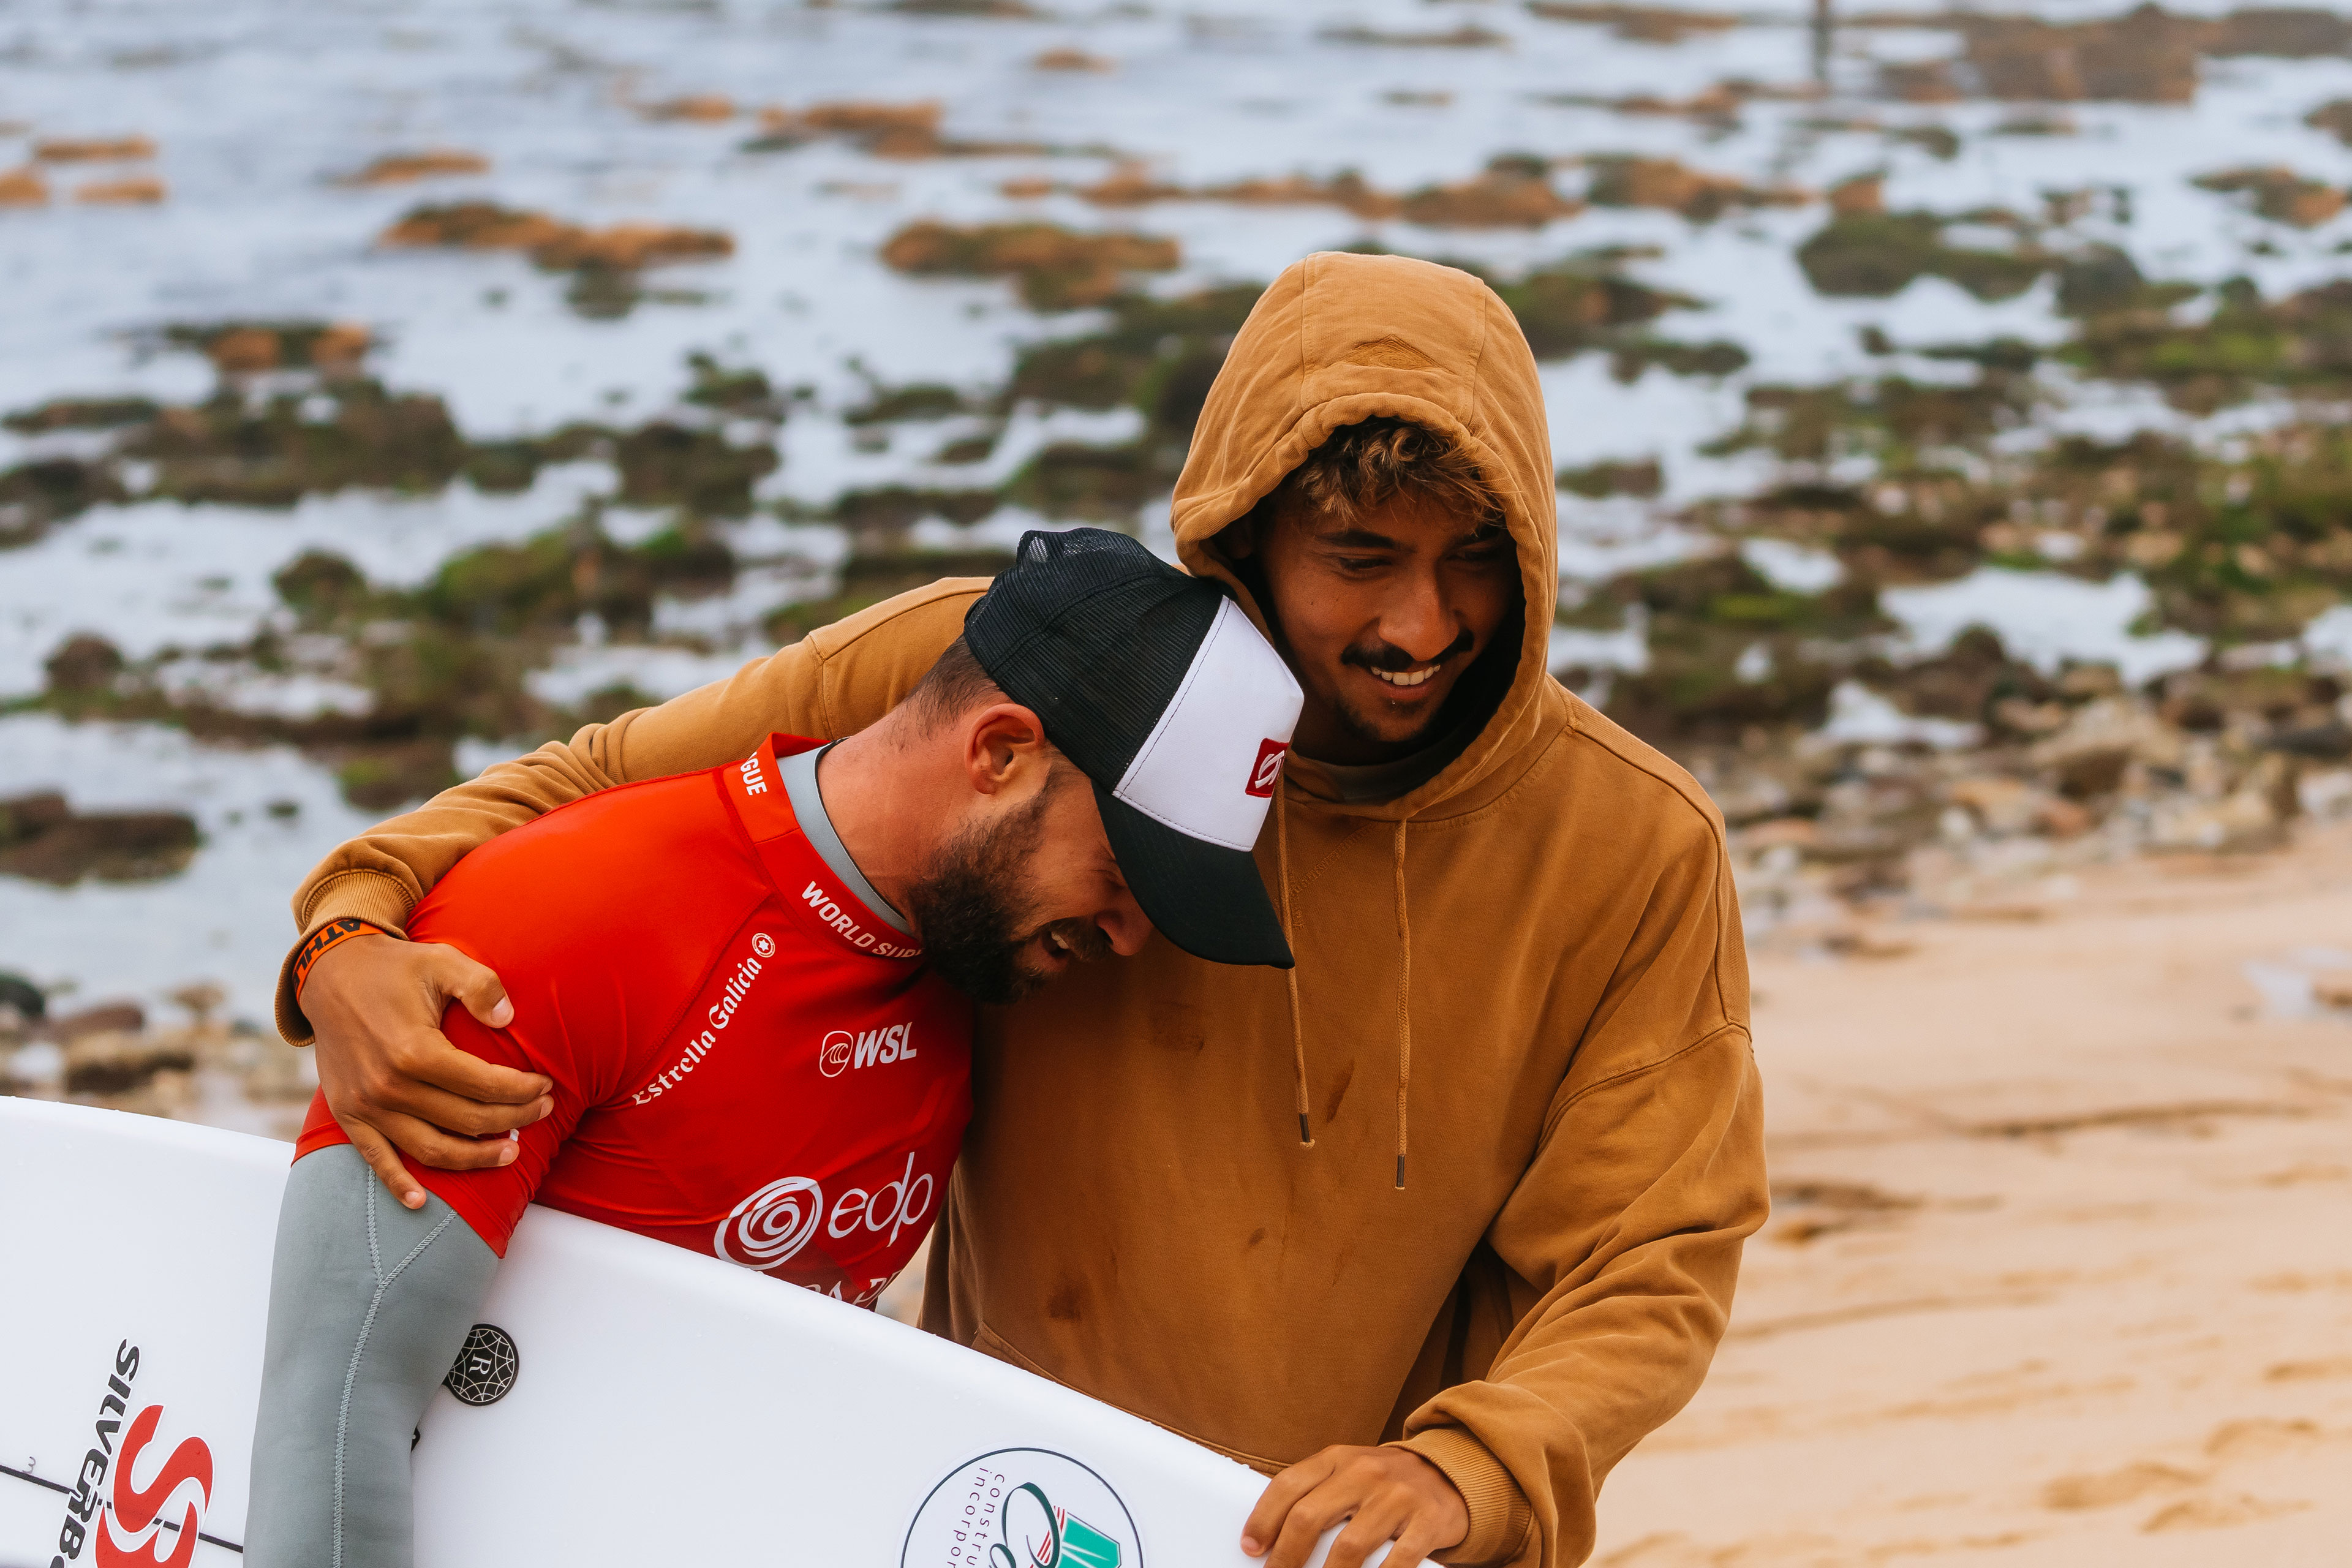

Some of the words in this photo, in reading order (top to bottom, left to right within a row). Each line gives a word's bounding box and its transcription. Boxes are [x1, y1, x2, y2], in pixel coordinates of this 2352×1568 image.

[802, 880, 876, 948] WORLD
[631, 1030, 716, 1106] Estrella
[709, 957, 762, 1029] Galicia
[854, 1022, 917, 1069] WSL
[828, 1152, 933, 1247] edp
[469, 1353, 492, 1375] R
